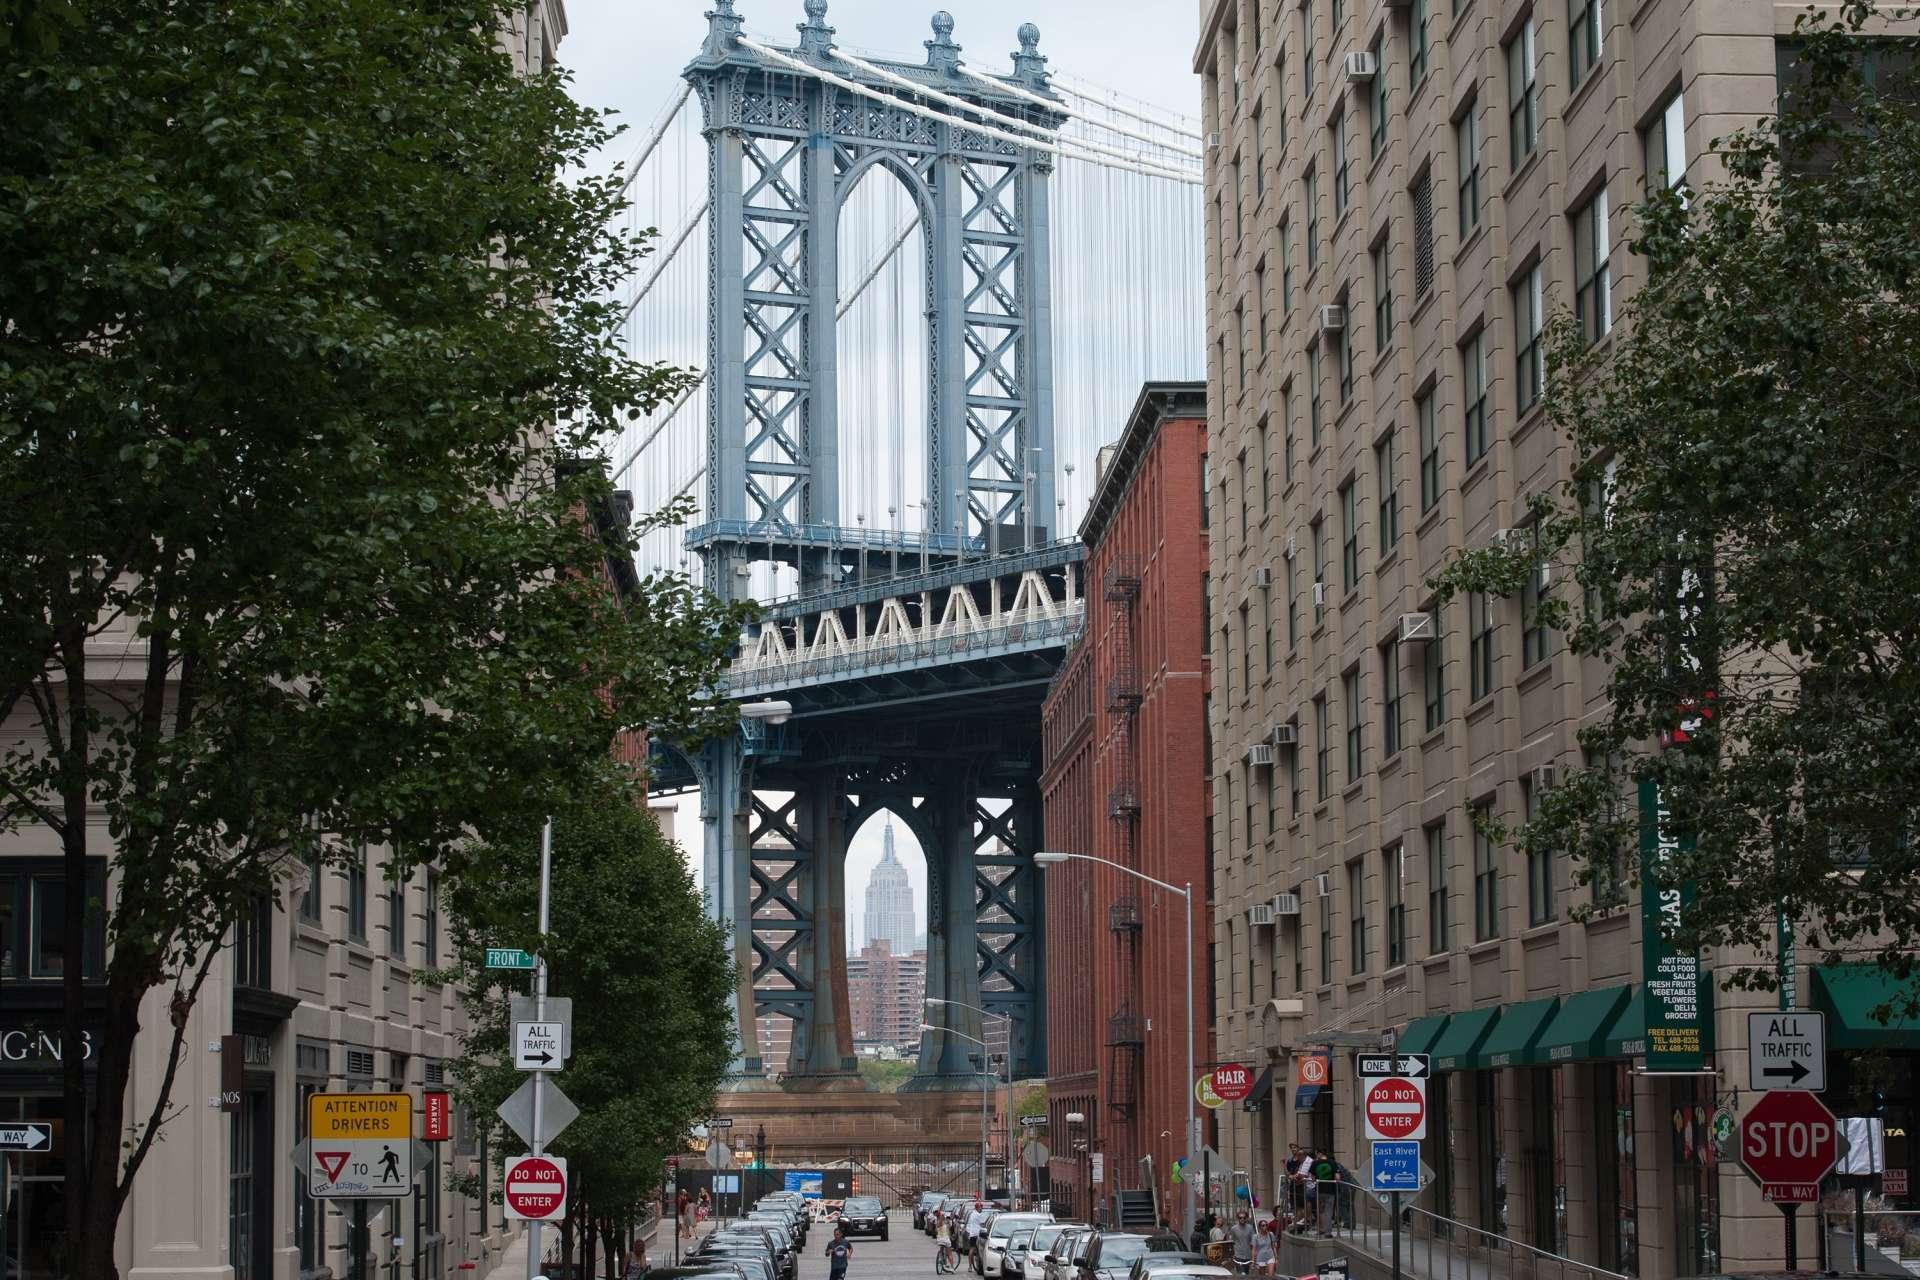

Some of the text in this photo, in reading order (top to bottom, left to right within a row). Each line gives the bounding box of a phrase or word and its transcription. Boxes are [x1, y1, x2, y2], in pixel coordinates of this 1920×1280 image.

[488, 951, 521, 966] FRONT
[1662, 957, 1696, 965] HOT FOOD
[1664, 1012, 1697, 1020] GROCERY
[528, 1026, 551, 1038] ALL
[1768, 1019, 1804, 1037] ALL
[523, 1040, 556, 1050] TRAFFIC
[1761, 1042, 1812, 1058] TRAFFIC
[1366, 1061, 1385, 1071] ONE
[1216, 1070, 1246, 1085] HAIR
[1374, 1090, 1415, 1100] DO NOT
[325, 1101, 398, 1113] ATTENTION
[331, 1118, 390, 1130] DRIVERS
[1378, 1117, 1412, 1127] ENTER
[4, 1132, 27, 1142] WAY
[1748, 1121, 1830, 1158] STOP
[1374, 1147, 1416, 1156] East River
[1384, 1159, 1407, 1168] Ferry
[352, 1163, 368, 1176] TO
[514, 1170, 557, 1180] DO NOT
[1766, 1187, 1814, 1199] ALL WAY
[518, 1196, 552, 1207] ENTER
